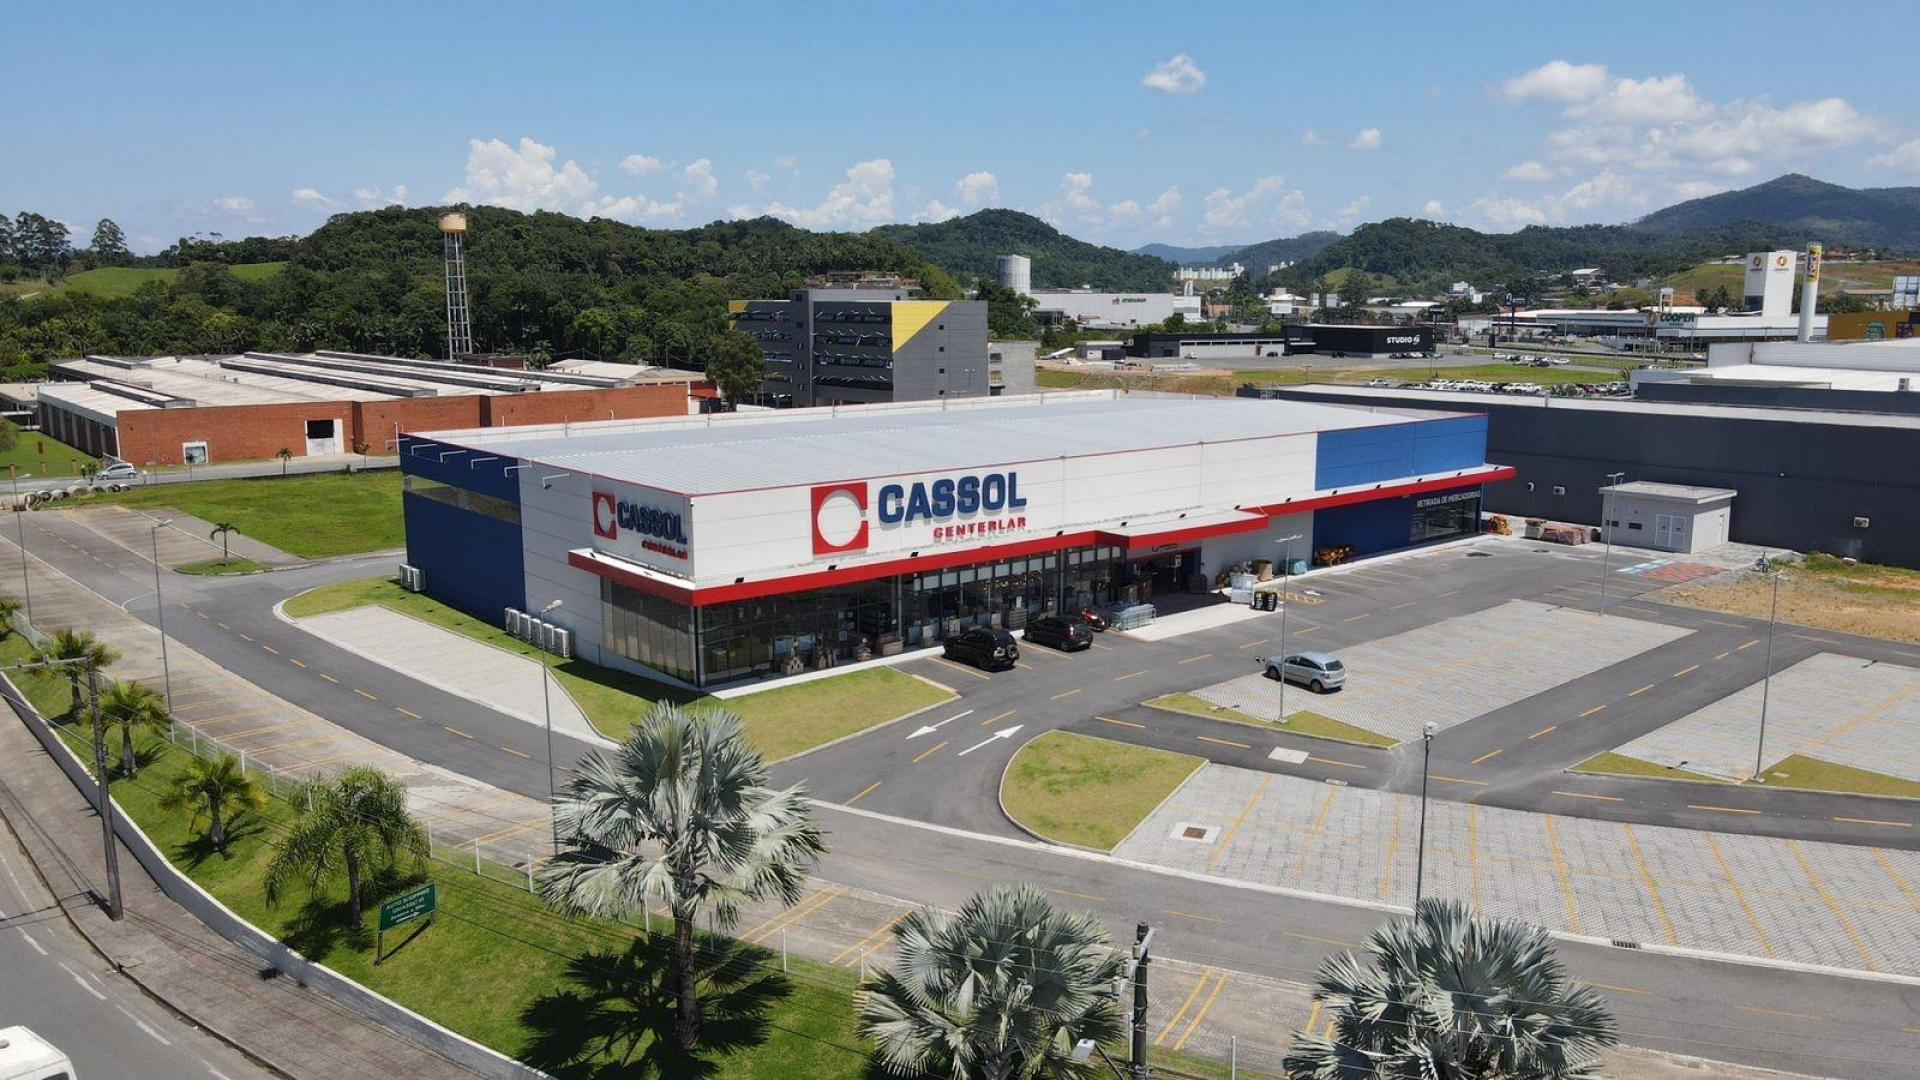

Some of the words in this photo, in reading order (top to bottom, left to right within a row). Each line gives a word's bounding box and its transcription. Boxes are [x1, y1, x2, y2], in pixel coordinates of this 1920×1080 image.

[1660, 312, 1695, 323] COOPER
[1386, 336, 1412, 344] STUDIO
[878, 472, 1027, 524] CASSOL
[1416, 497, 1440, 508] RETIRADA
[617, 501, 688, 545] CASSOL
[933, 516, 1027, 539] CENTERLAR
